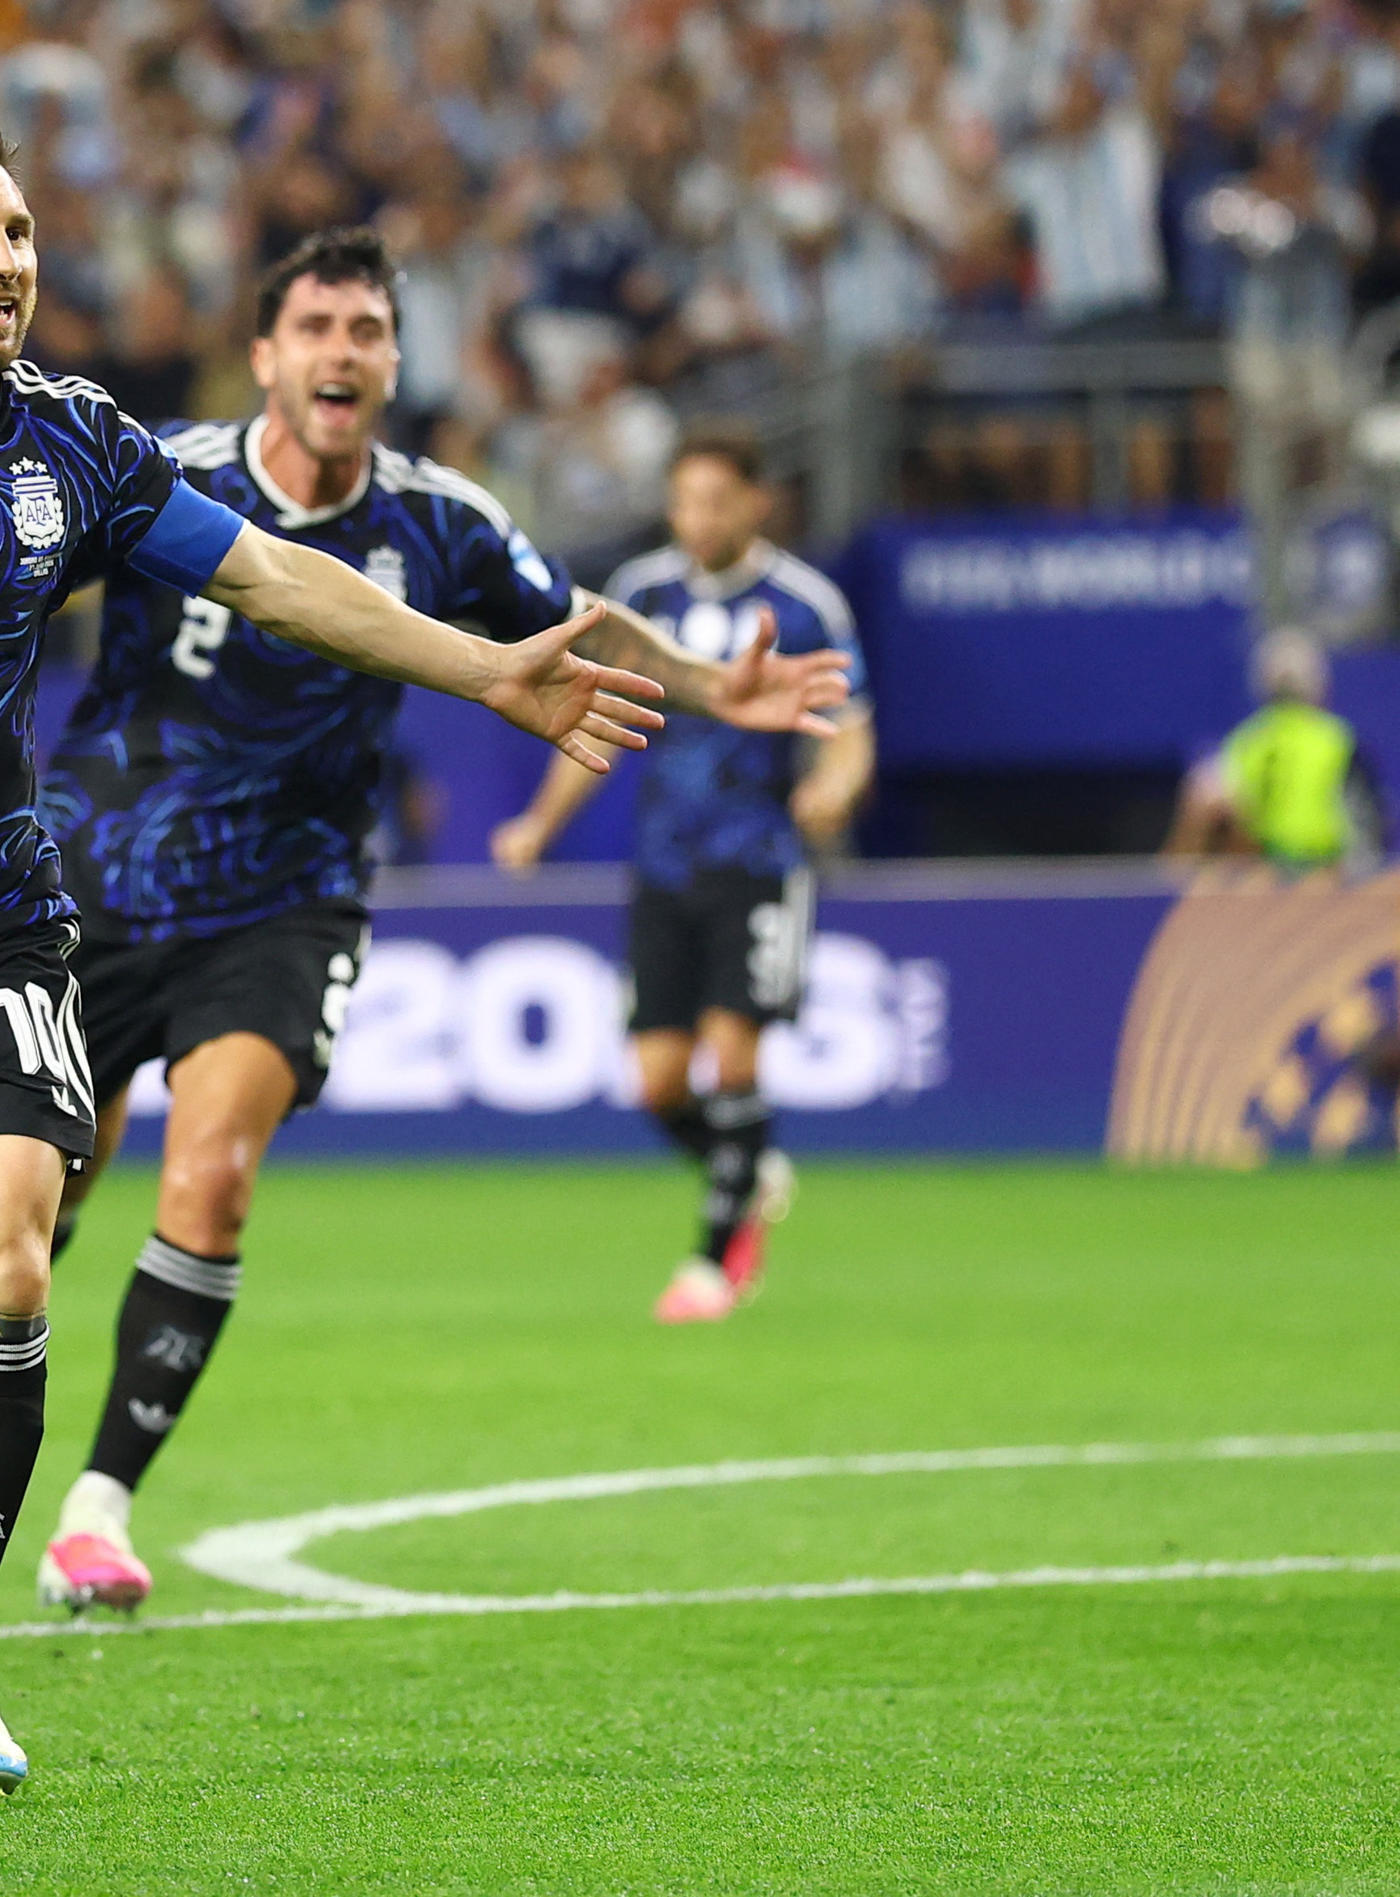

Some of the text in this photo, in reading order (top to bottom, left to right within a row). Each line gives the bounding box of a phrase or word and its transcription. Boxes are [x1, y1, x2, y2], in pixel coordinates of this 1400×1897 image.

[26, 496, 53, 527] AFA
[171, 597, 232, 680] 2
[320, 933, 896, 1113] 206
